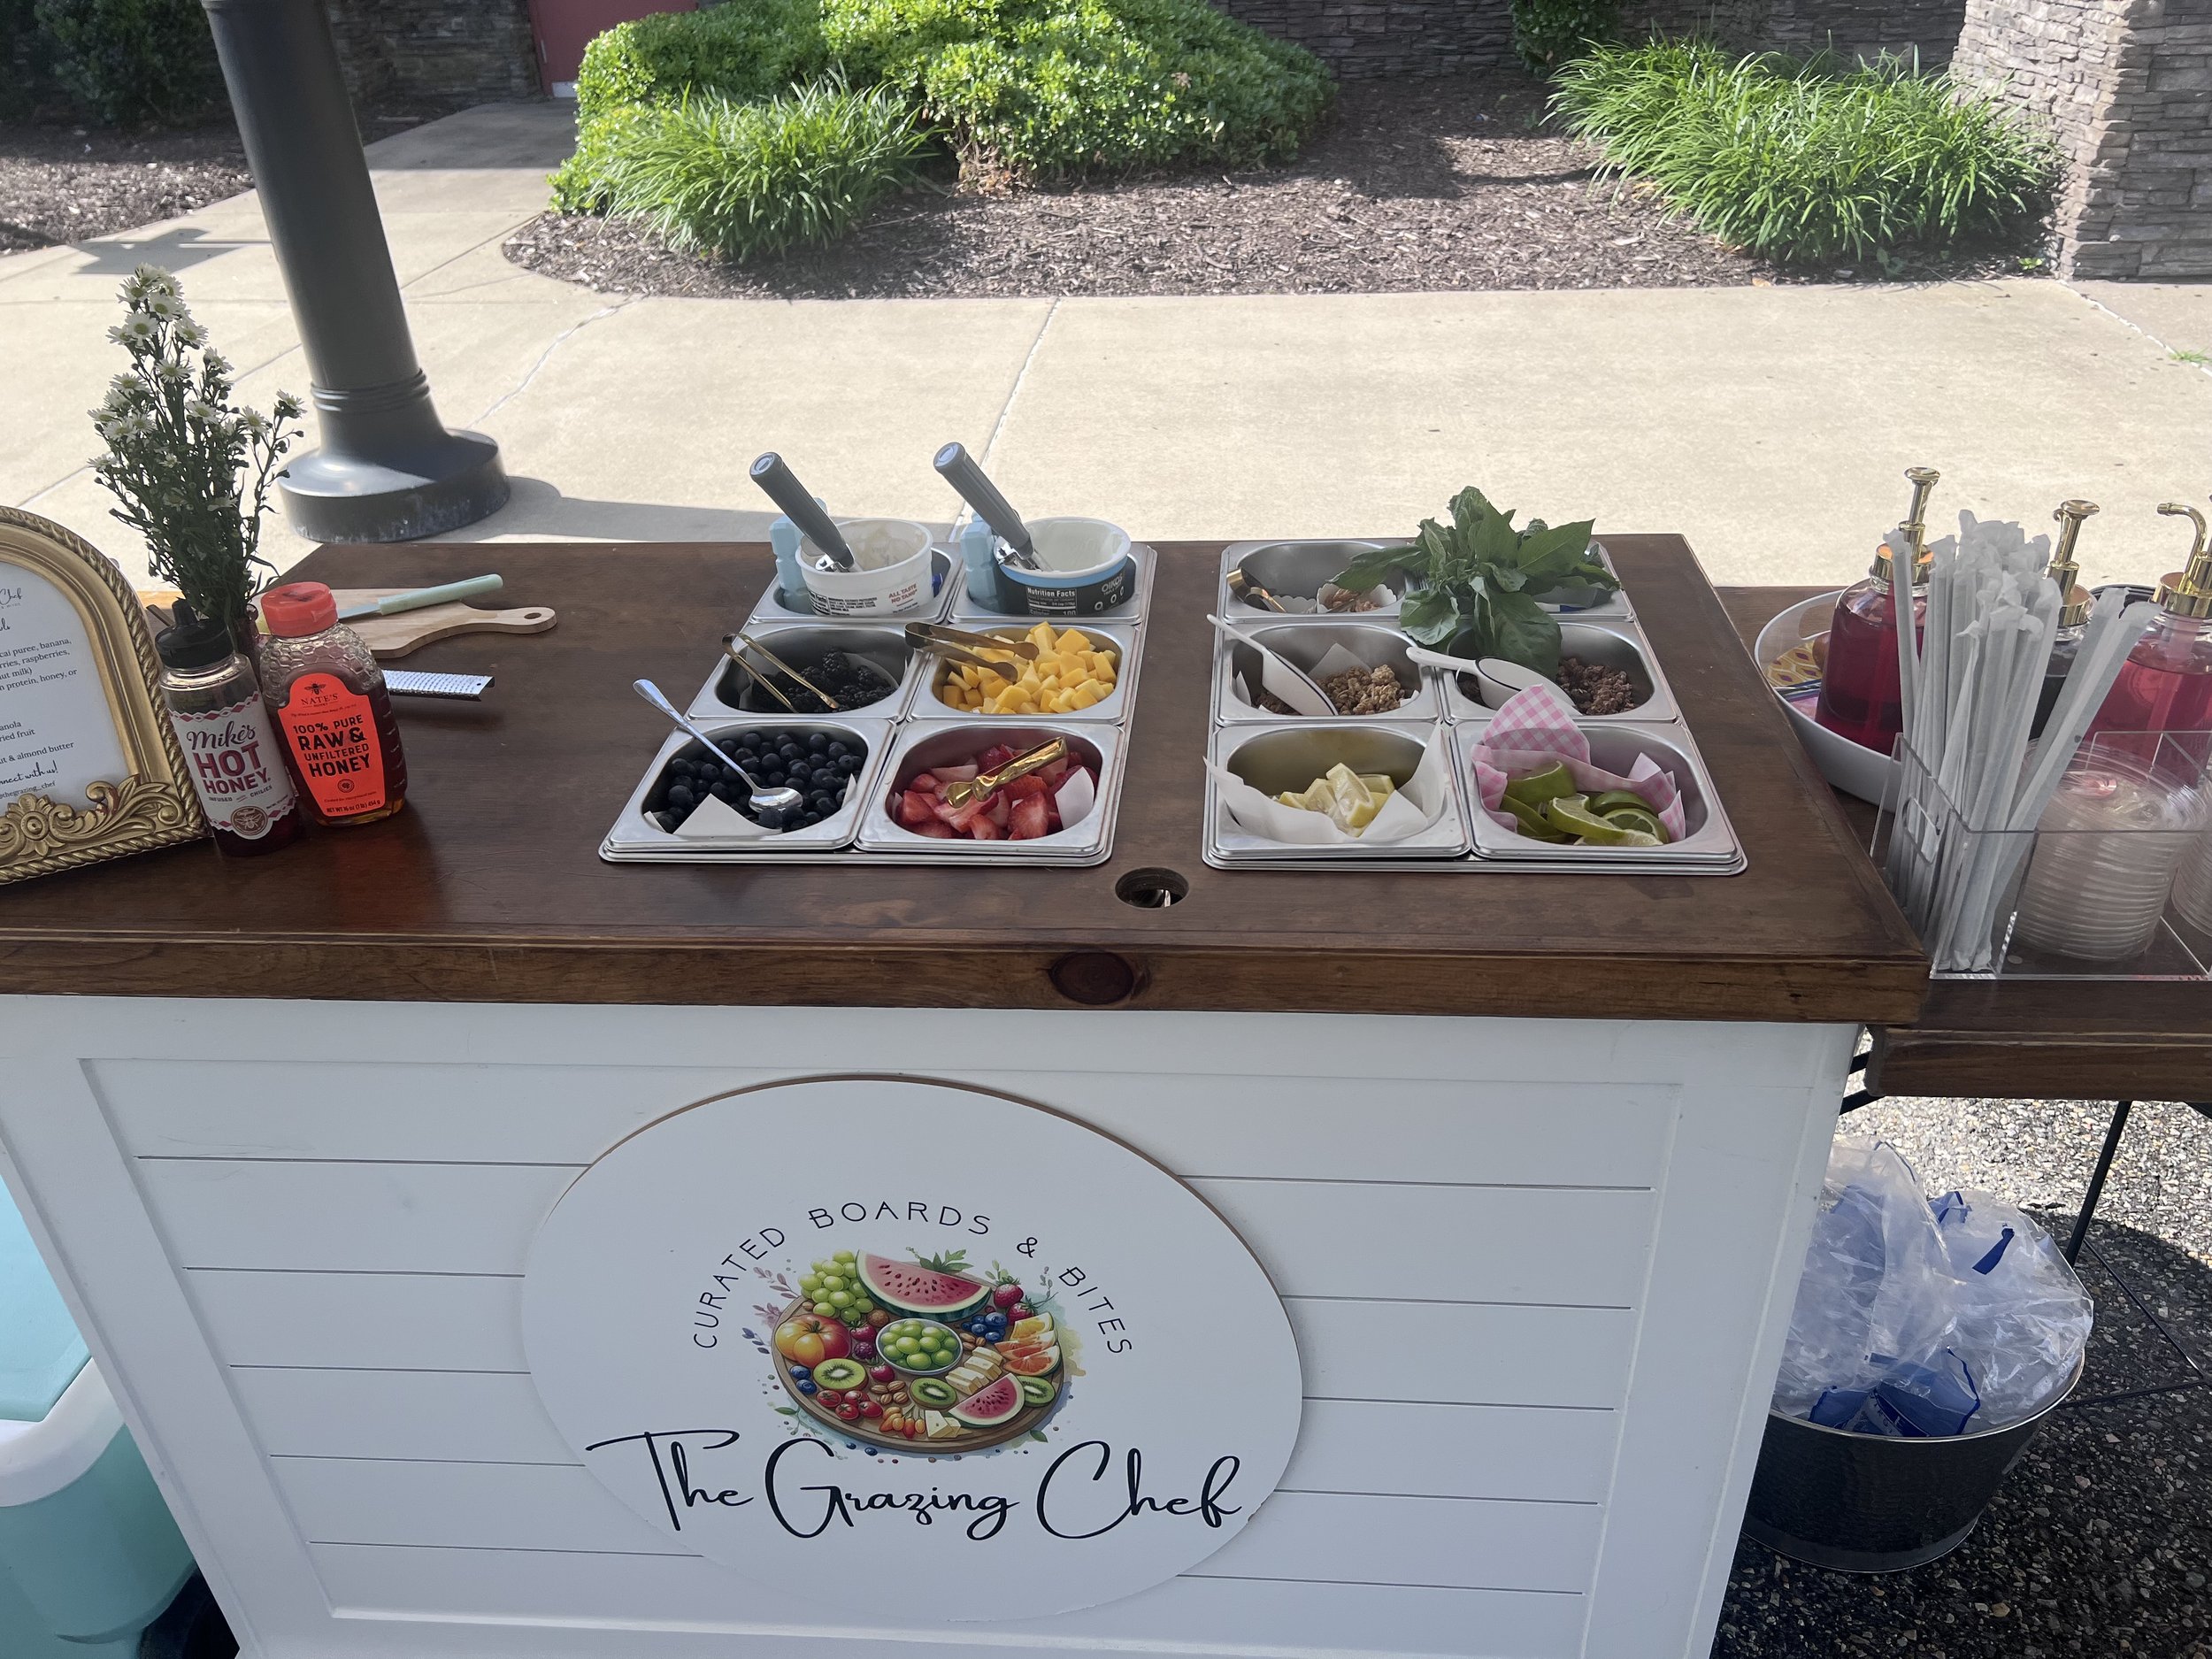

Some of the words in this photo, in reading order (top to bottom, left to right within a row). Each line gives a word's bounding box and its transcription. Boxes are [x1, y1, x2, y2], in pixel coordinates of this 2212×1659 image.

[901, 583, 917, 594] TASTE
[1027, 587, 1055, 597] Nutrition
[12, 645, 39, 657] puree,
[39, 638, 72, 649] banana,
[22, 649, 71, 664] raspberries,
[12, 666, 33, 676] milk)
[6, 678, 39, 690] protein,
[39, 672, 67, 682] honey,
[301, 694, 339, 705] NATE'S
[17, 728, 35, 738] fruit
[293, 723, 328, 734] 100%
[333, 714, 364, 729] PURE
[186, 720, 257, 750] Mike's
[297, 730, 343, 751] RAW
[349, 726, 367, 743] &
[17, 747, 48, 760] almond
[48, 742, 74, 753] butter
[193, 741, 262, 779] HOT
[304, 743, 369, 762] UNFILTERED
[25, 762, 46, 779] with
[308, 753, 370, 778] HONEY
[250, 785, 273, 797] CHILIES
[693, 1227, 786, 1348] CURATED
[807, 1201, 991, 1235] BOARDS
[1016, 1236, 1039, 1259] &
[1058, 1266, 1133, 1354] BITES
[585, 1429, 755, 1532] The
[764, 1437, 1021, 1541] Grazing
[1036, 1440, 1243, 1540] Chef
